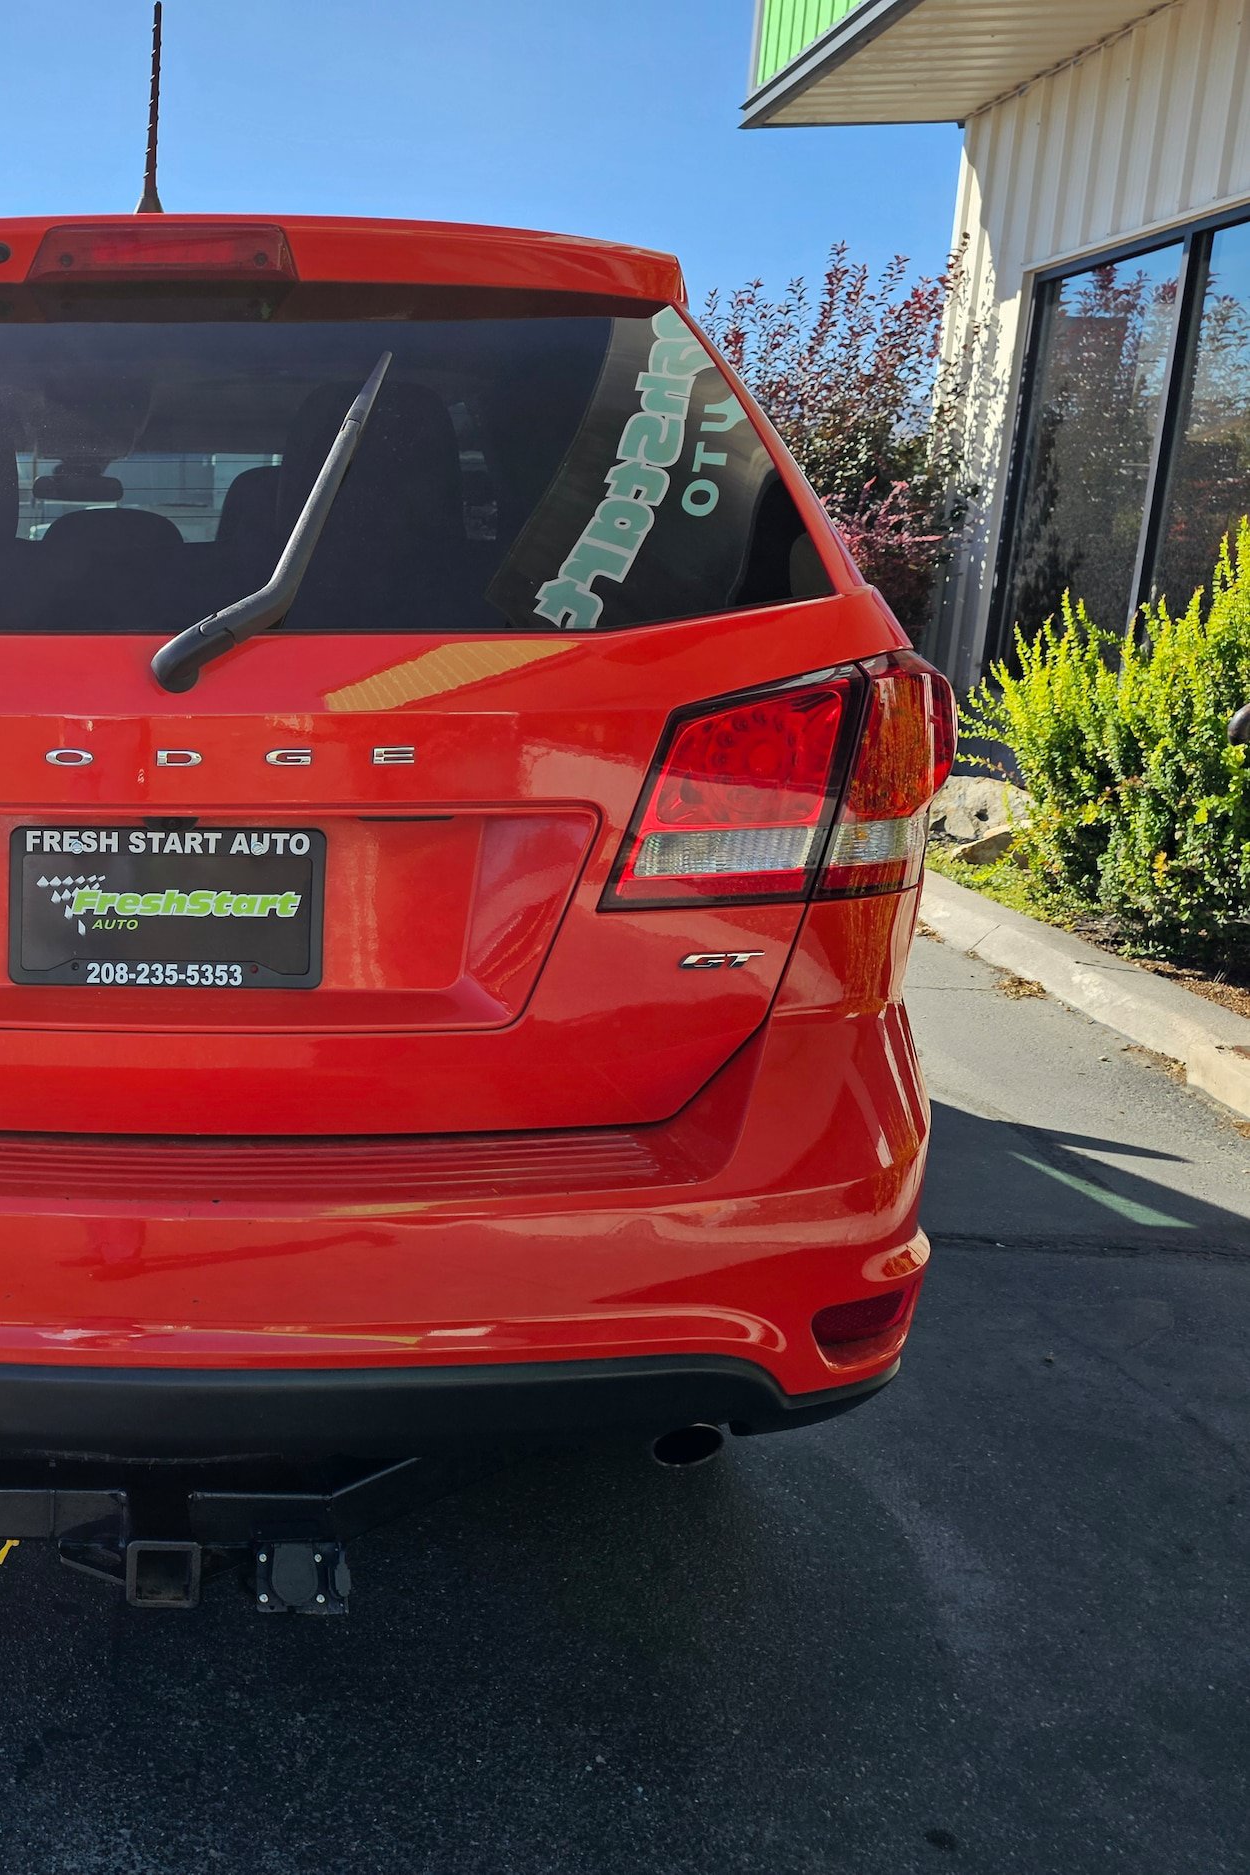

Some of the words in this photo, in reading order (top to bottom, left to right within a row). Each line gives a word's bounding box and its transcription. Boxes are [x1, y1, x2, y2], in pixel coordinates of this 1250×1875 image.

[26, 830, 119, 853] FRESH
[128, 831, 222, 854] START
[230, 833, 311, 855] AUTO
[70, 889, 302, 918] FreshStart
[91, 918, 139, 931] AUTO
[679, 951, 766, 969] GT
[86, 962, 243, 987] 208-235-5353
